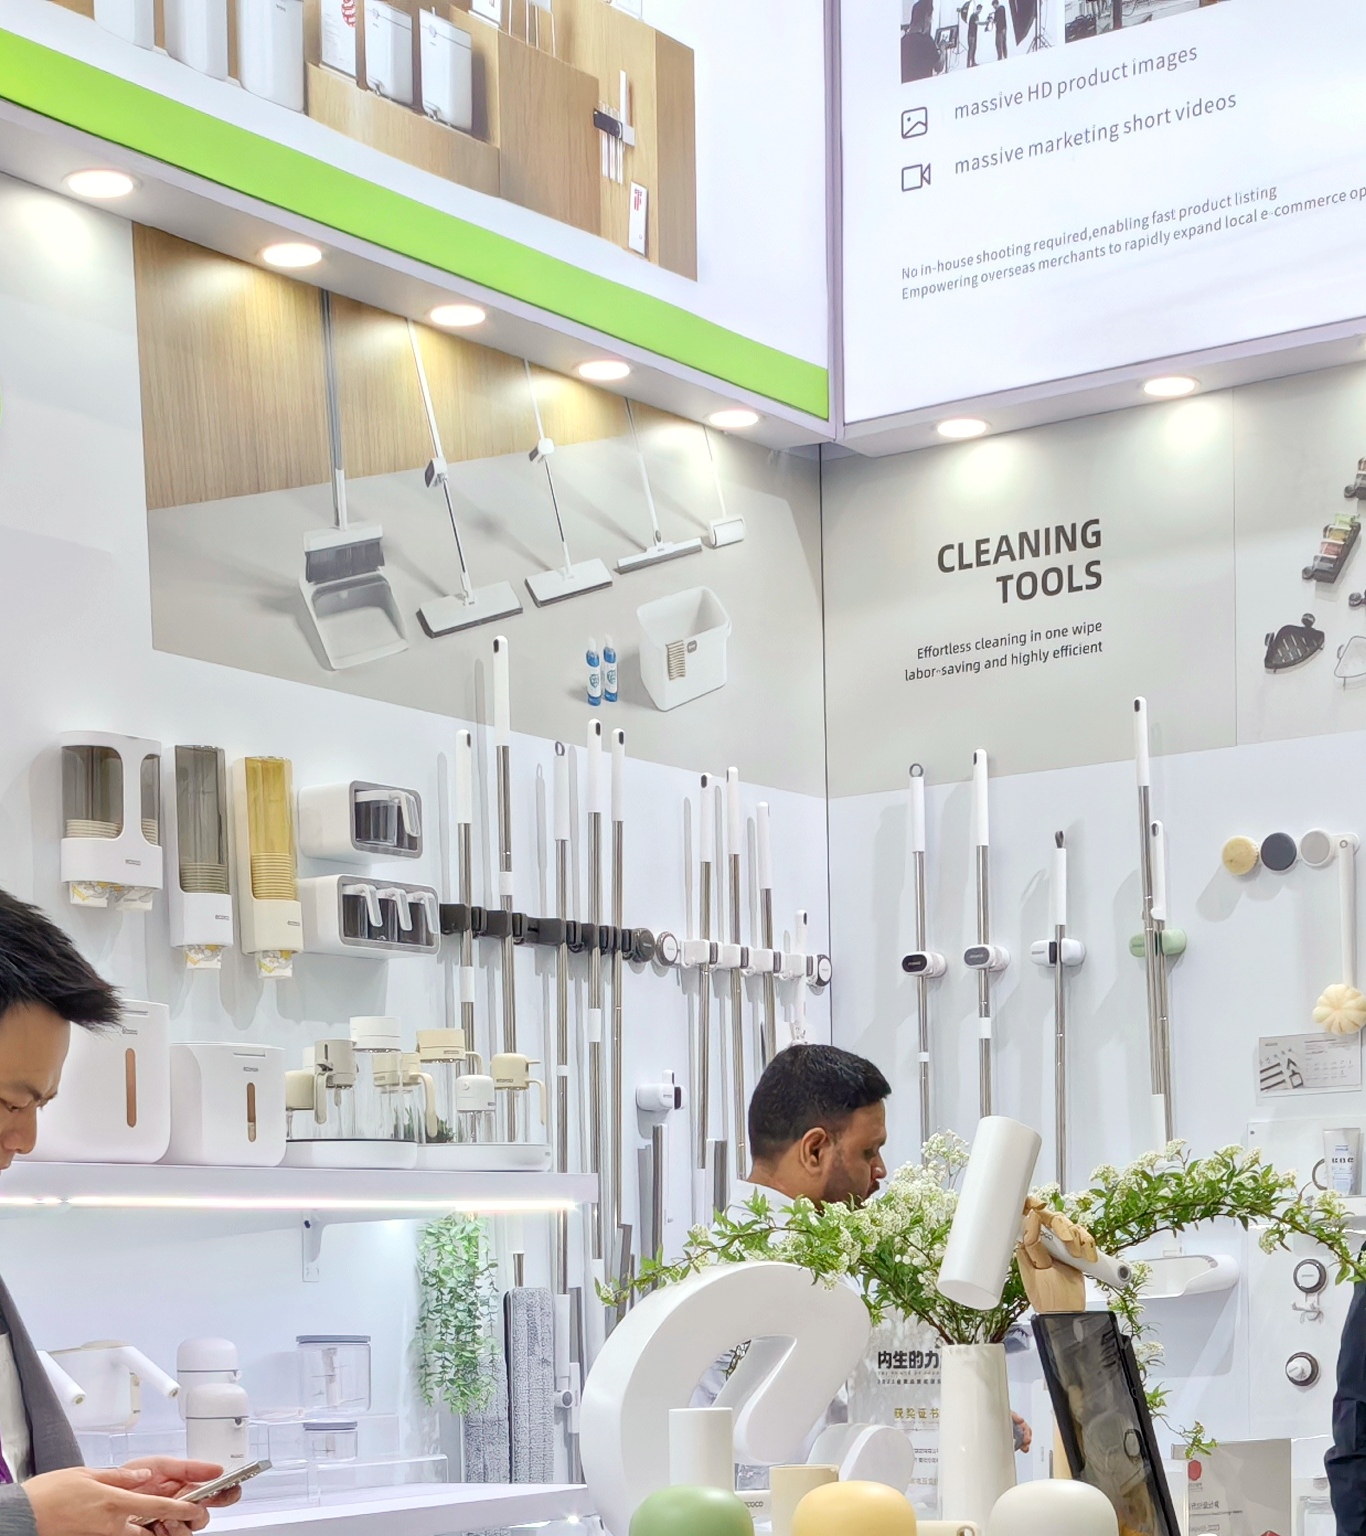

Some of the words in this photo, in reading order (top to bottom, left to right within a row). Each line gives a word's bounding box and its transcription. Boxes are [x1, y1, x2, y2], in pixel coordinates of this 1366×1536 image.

[955, 91, 1024, 120] massive
[1028, 81, 1053, 102] HD
[1057, 63, 1128, 99] product
[1132, 46, 1198, 76] images
[955, 146, 1024, 174] massive
[1028, 124, 1120, 158] marketing
[1123, 108, 1172, 135] short
[1176, 93, 1237, 122] videos
[901, 273, 979, 300] Empowering
[980, 262, 1036, 284] overseas
[1038, 244, 1107, 271] merchants
[1108, 240, 1122, 254] to
[1124, 230, 1171, 252] rapidly
[1173, 219, 1222, 241] expand
[1224, 208, 1258, 230] local
[1260, 191, 1347, 222] e-commerce
[920, 253, 974, 276] in-house
[975, 239, 1032, 265] shooting
[1033, 214, 1150, 251] required,enabling
[1152, 208, 1177, 225] fast
[1178, 195, 1233, 222] product
[1235, 185, 1278, 207] listing
[937, 517, 1102, 575] CLEANING
[996, 559, 1103, 605] TOOLS
[904, 655, 981, 682] labor-saving
[984, 650, 1008, 669] and
[1010, 646, 1050, 669] highly
[1052, 640, 1104, 660] efficient
[916, 638, 972, 660] Effortless
[974, 632, 1027, 652] cleaning
[1030, 629, 1043, 643] in
[1045, 627, 1068, 641] one
[1071, 620, 1103, 640] wipe
